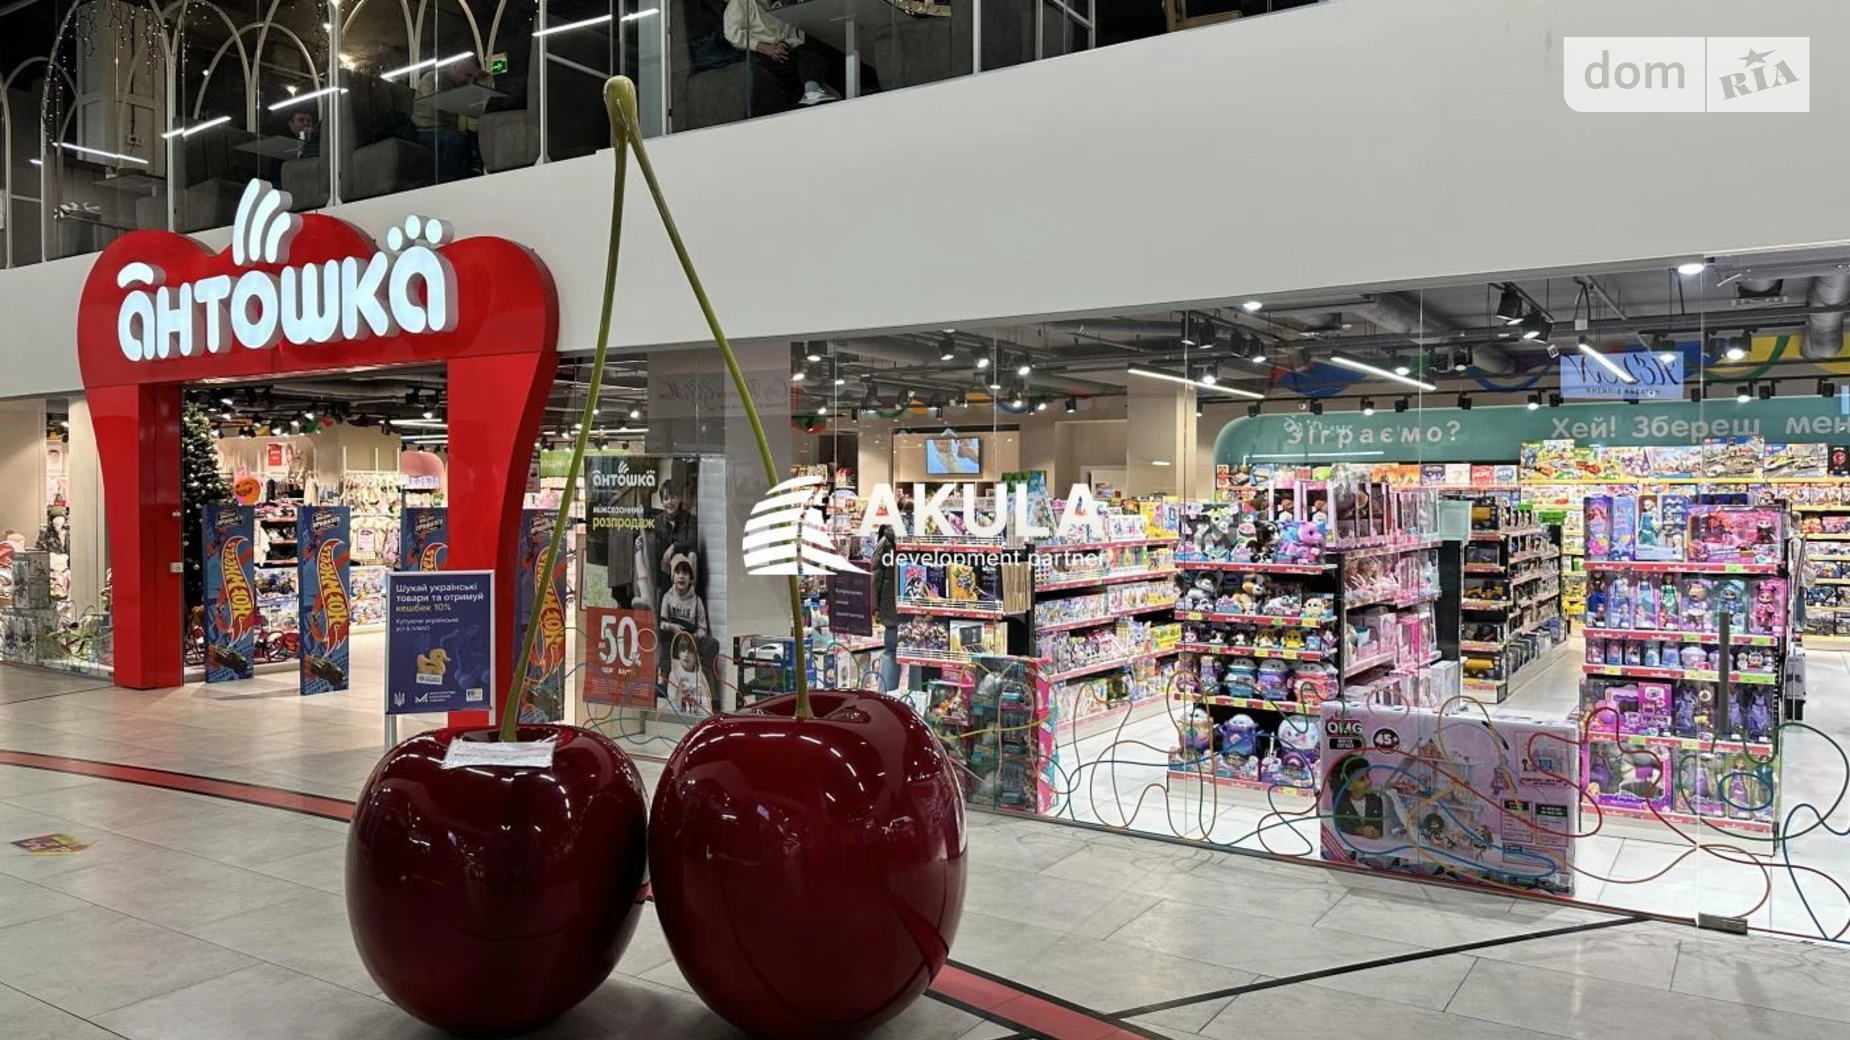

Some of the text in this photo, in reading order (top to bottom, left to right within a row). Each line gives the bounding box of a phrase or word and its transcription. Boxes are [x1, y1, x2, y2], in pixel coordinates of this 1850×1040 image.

[1552, 417, 1616, 439] Хей!
[1632, 416, 1761, 443] Збереш
[592, 516, 656, 531] розпродаж
[396, 582, 478, 593] Шукай українські
[396, 595, 429, 603] товари
[443, 593, 485, 603] отримуй
[396, 603, 452, 612] кешбек 10%
